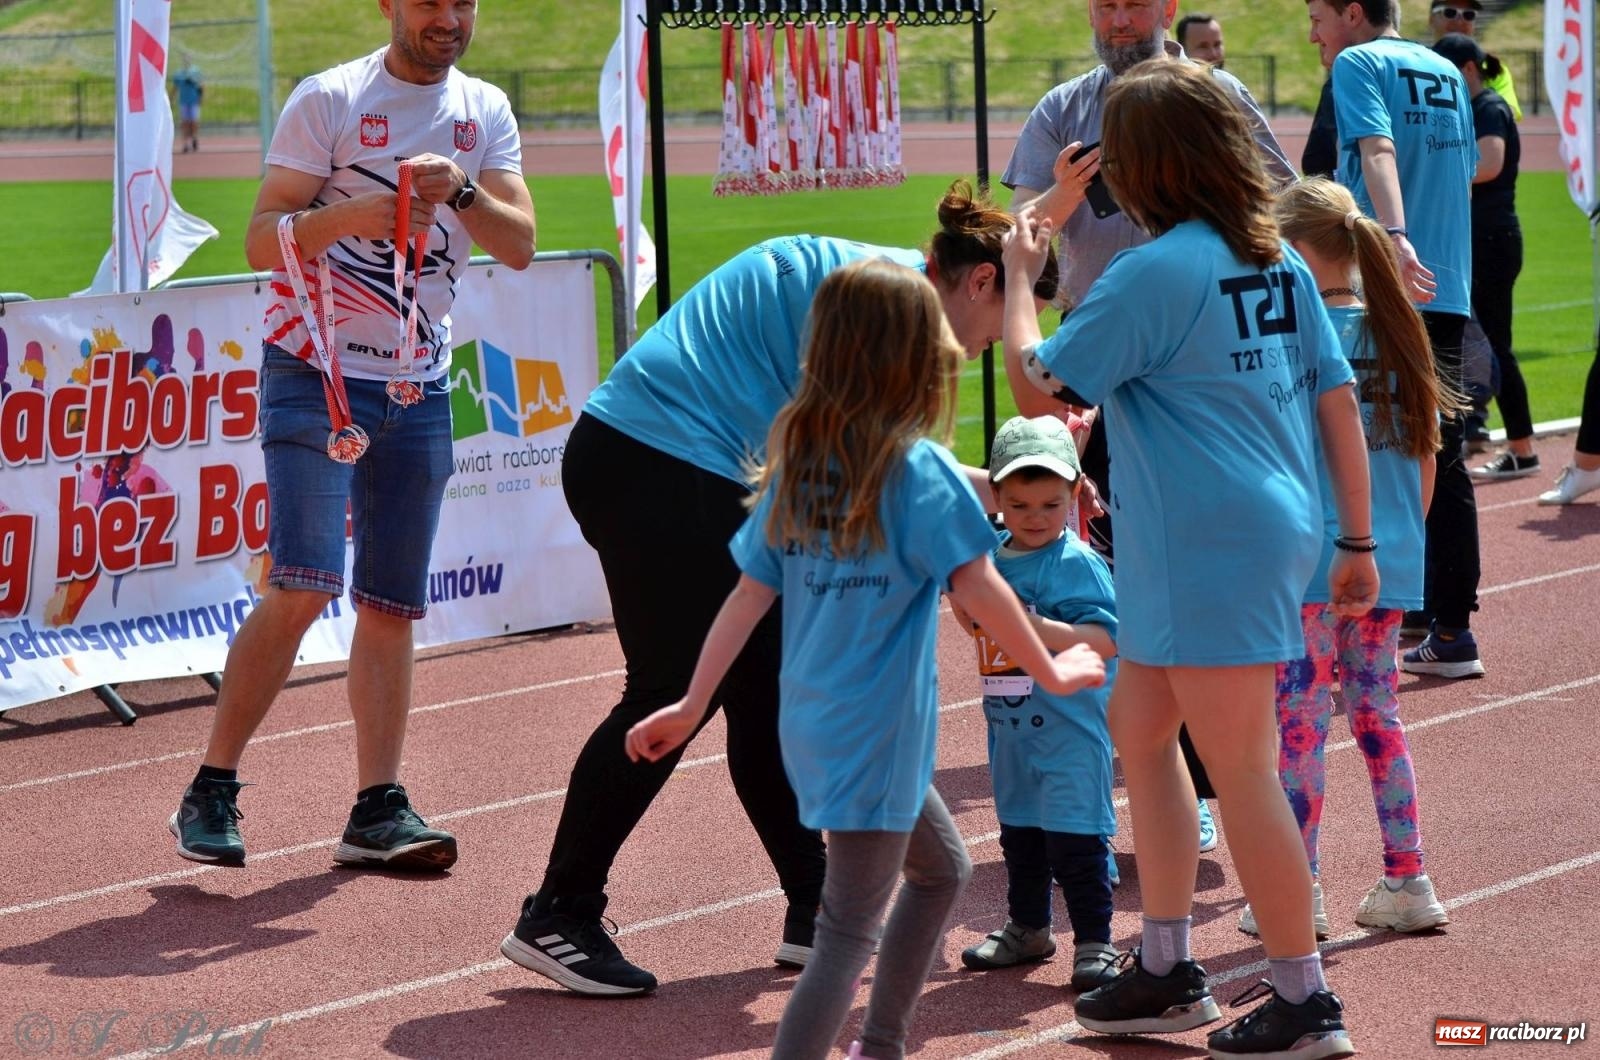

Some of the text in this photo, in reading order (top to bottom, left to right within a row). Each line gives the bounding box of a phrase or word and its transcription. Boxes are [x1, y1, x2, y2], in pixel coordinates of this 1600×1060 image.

[1403, 111, 1428, 125] T2T
[1218, 270, 1298, 341] T2T
[1229, 348, 1264, 374] T2T
[0, 349, 262, 467] acibors
[502, 439, 568, 468] racibors
[442, 470, 562, 500] ielona oaza kul
[57, 475, 178, 582] bez
[196, 464, 271, 562] Ba
[427, 555, 504, 605] unów
[0, 584, 264, 679] pełnosprawnyc
